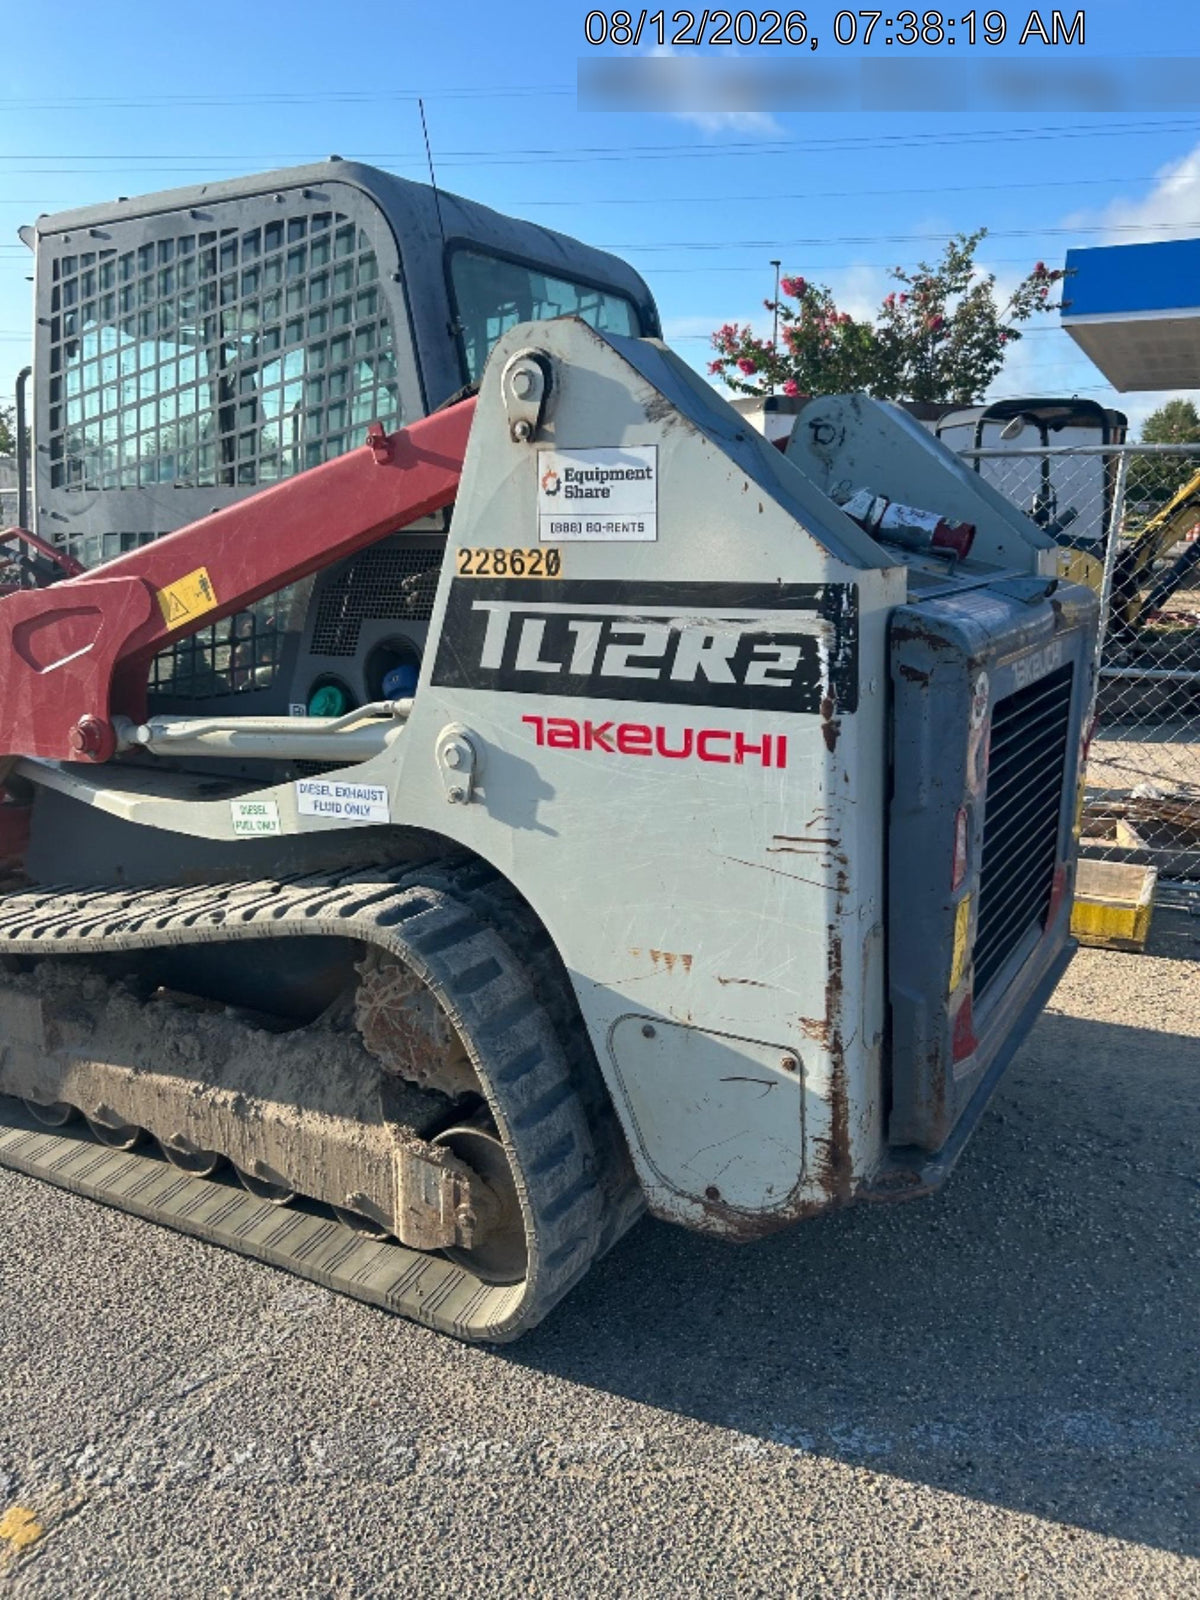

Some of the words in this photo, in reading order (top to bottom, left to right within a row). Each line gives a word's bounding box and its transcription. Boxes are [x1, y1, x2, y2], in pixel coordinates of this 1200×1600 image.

[564, 466, 653, 484] Equipment
[564, 485, 610, 499] Share
[586, 522, 645, 533] 80-RENTS
[458, 548, 562, 577] 228620
[472, 600, 819, 688] TL12R2
[299, 783, 333, 797] DIESEL
[335, 787, 385, 802] EXHAUST
[313, 799, 342, 813] FLUID
[344, 802, 371, 816] ONLY
